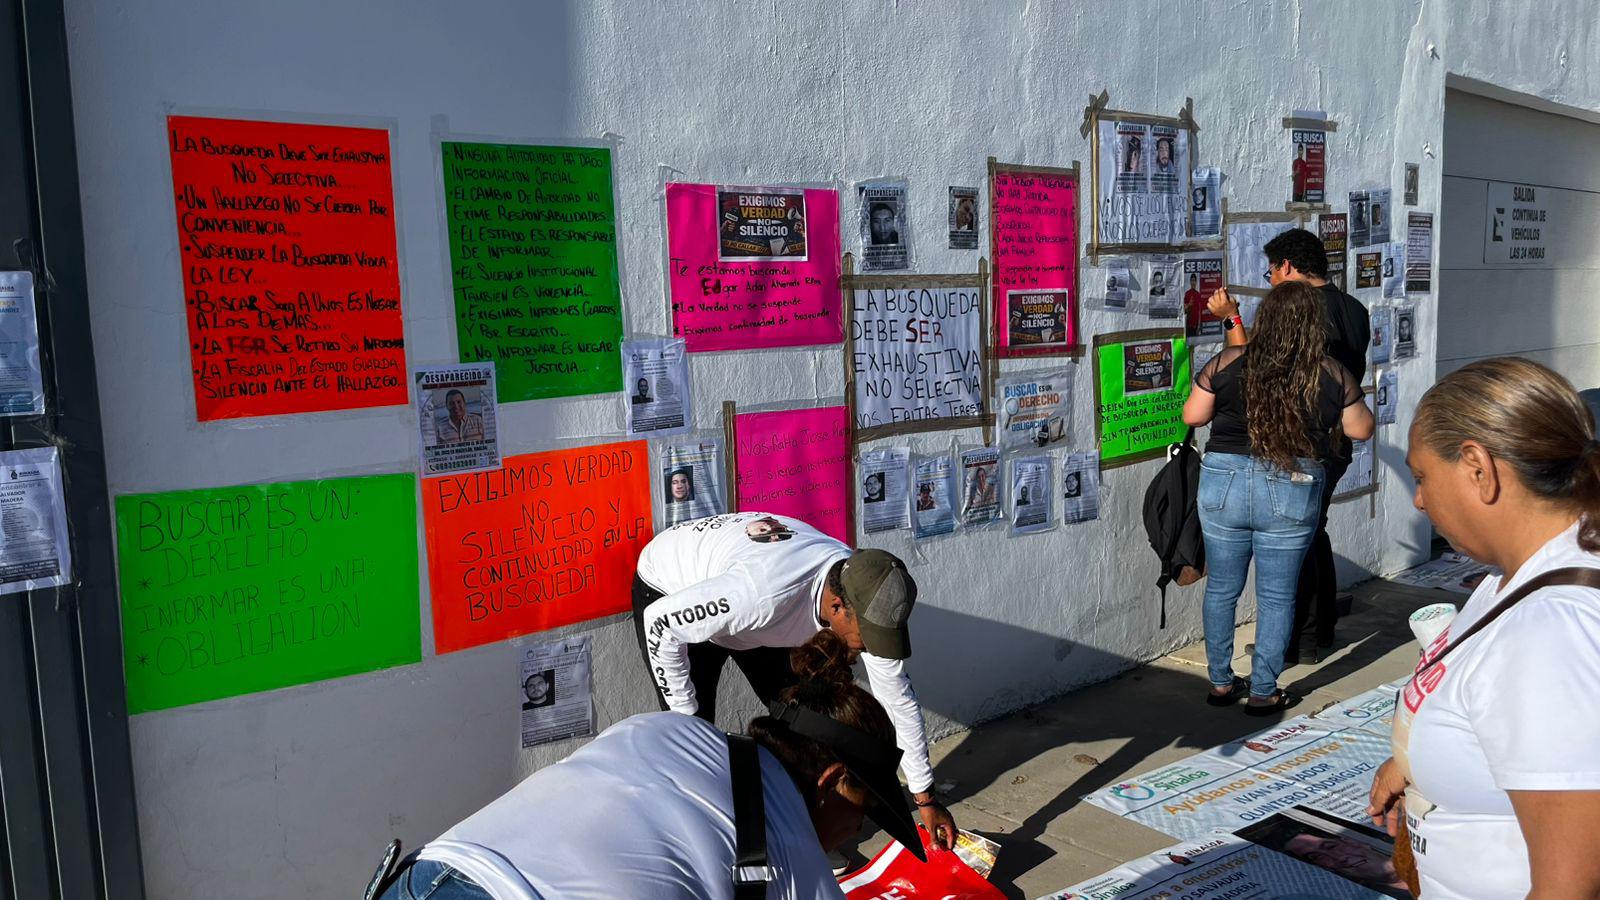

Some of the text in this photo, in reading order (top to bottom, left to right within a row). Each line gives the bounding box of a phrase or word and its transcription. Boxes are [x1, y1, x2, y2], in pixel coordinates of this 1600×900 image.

[172, 129, 198, 153] LA
[1294, 132, 1324, 143] SE BUSCA
[563, 152, 575, 165] HA
[232, 161, 256, 184] NO
[184, 184, 207, 210] UN
[213, 184, 280, 211] HALLAZGO
[284, 197, 300, 215] NO
[305, 196, 323, 214] SE
[368, 199, 387, 217] POR
[454, 186, 465, 200] EL
[470, 187, 512, 201] CAMBIO
[518, 189, 531, 204] DE
[587, 192, 600, 201] NO
[739, 195, 786, 207] EXIGIMOS
[1513, 187, 1535, 202] SALIDA
[741, 207, 785, 219] VERDAD
[1512, 208, 1546, 222] CONTINUA DE
[461, 225, 473, 242] EL
[531, 229, 546, 241] ES
[739, 225, 788, 237] SILENCIO
[1321, 220, 1345, 233] BUSCAR
[1511, 225, 1540, 240] VEHÍCULOS
[272, 244, 288, 263] LA
[461, 245, 477, 259] DE
[1510, 247, 1545, 259] LAS 24 HORAS
[191, 266, 212, 285] LA
[461, 267, 475, 280] EL
[671, 258, 746, 277] Te estamos
[1186, 261, 1222, 272] SE BUSCA
[512, 285, 529, 299] ES
[1022, 295, 1054, 305] EXIGIMOS
[195, 290, 260, 314] BUSCAR
[298, 291, 310, 312] A
[347, 291, 363, 311] ES
[853, 288, 980, 319] LA BUSQUEDA
[1023, 304, 1053, 313] VERDAD
[196, 312, 249, 330] A LOS
[1022, 319, 1054, 328] SILENCIO
[464, 324, 503, 338] Y POR
[851, 318, 944, 345] DEBE SER
[201, 336, 223, 355] LA
[271, 335, 293, 354] SE
[474, 345, 492, 360] NO
[562, 341, 573, 355] ES
[578, 341, 613, 353] NEGAR
[1135, 345, 1162, 355] EXIGIMOS
[854, 348, 981, 375] EXHAUSTIVA
[1136, 353, 1161, 362] VERDAD
[200, 356, 222, 381] LA
[309, 357, 348, 374] ESTADO
[352, 356, 398, 372] GUARDA
[425, 371, 482, 383] DESAPARECIDO
[1135, 366, 1163, 376] SILENCIO
[200, 376, 330, 400] SILENCIO ANTE EL
[866, 378, 892, 399] NO
[1005, 383, 1037, 398] BUSCAR
[1019, 393, 1059, 408] DERECHO
[855, 411, 883, 430] NOS
[1101, 416, 1110, 424] DE
[1102, 432, 1118, 443] SIN
[438, 450, 632, 512] EXIGIMOS VERDAD
[139, 493, 296, 551] BUSCAR ES
[521, 500, 550, 530] NO
[458, 507, 595, 564] SILENCIO
[162, 528, 308, 588] DERECHO
[464, 517, 645, 588] CONTINUIDAD EN LA
[136, 558, 366, 634] INFORMAR ES UNA
[466, 565, 596, 622] BUSQUEDA
[672, 598, 730, 627] TODOS
[1253, 773, 1269, 781] a
[1267, 742, 1343, 774] encontrar
[1154, 771, 1210, 791] Sinaloa
[1234, 763, 1334, 804] IVAN SALVADOR
[1239, 791, 1309, 821] QUINTERO
[1305, 762, 1376, 794] RODRÍGUEZ
[1184, 840, 1224, 856] SINALOA
[1182, 857, 1248, 886] encontrar
[1091, 881, 1136, 900] Sinaloa
